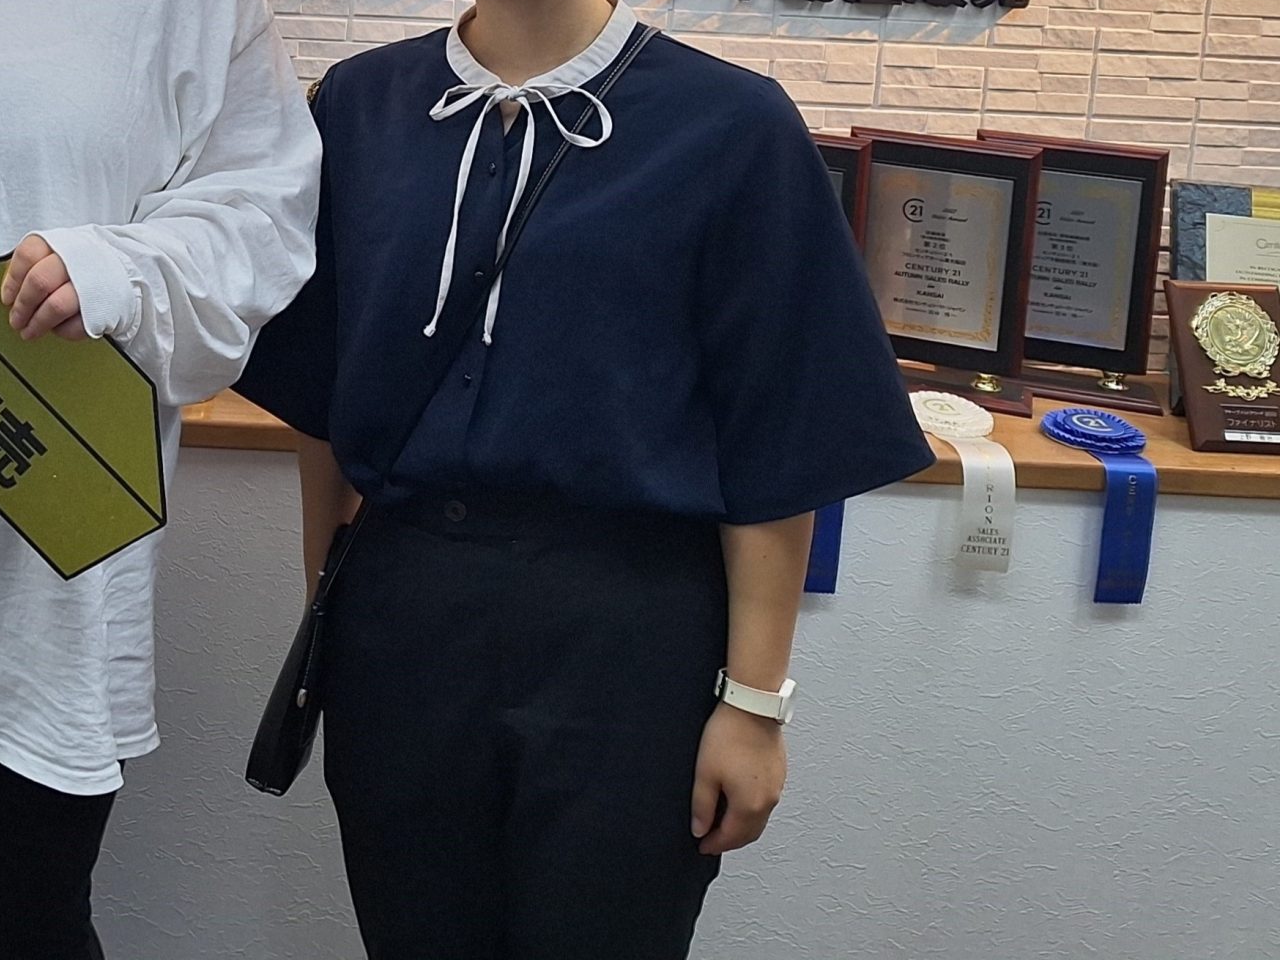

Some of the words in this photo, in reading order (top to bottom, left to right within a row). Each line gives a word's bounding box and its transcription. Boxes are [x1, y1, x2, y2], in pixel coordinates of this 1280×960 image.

[904, 262, 950, 276] CENTURY
[952, 269, 961, 277] 21
[1032, 265, 1078, 277] CENTURY
[960, 544, 998, 556] CENTURY
